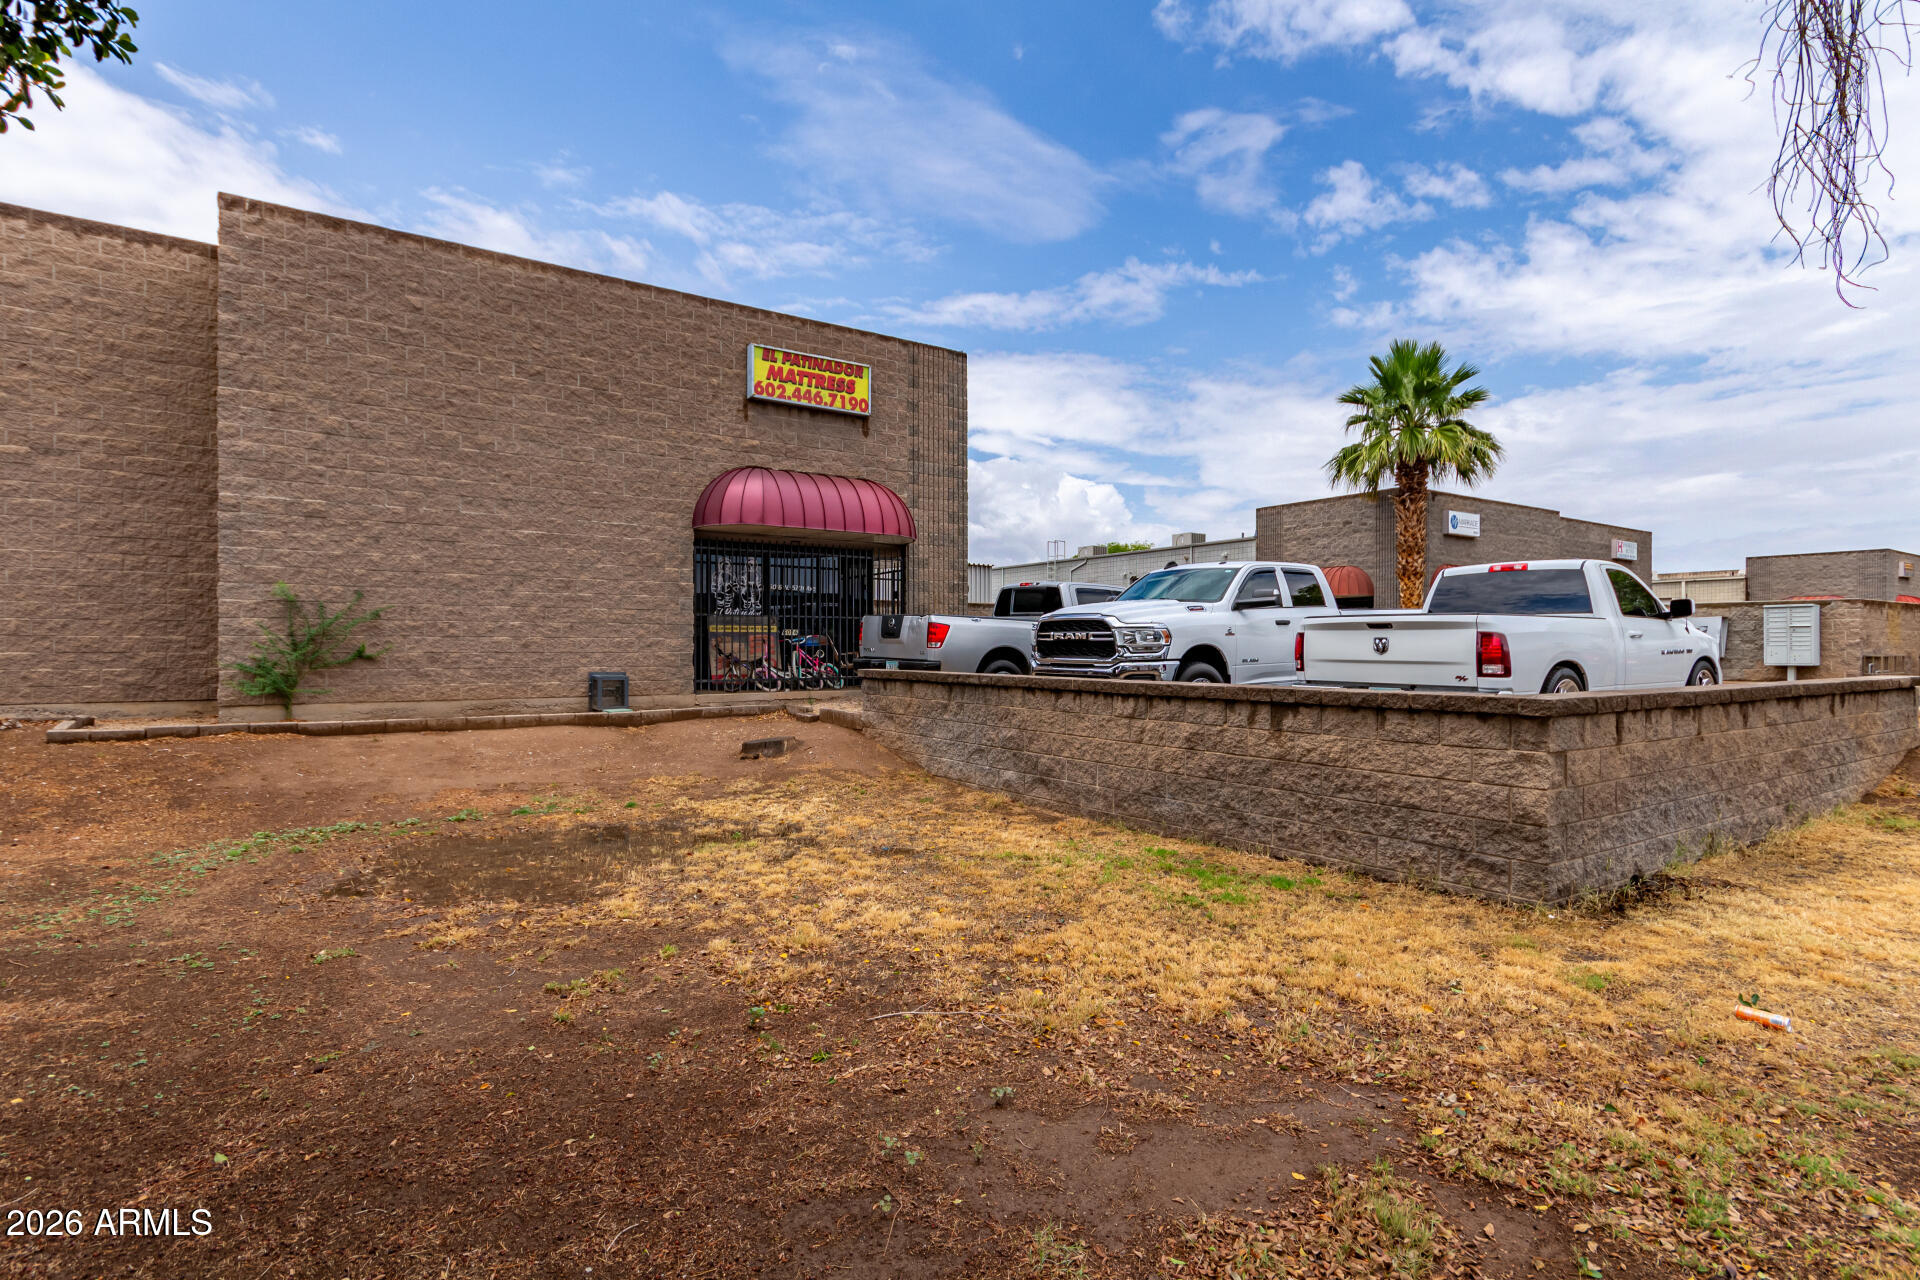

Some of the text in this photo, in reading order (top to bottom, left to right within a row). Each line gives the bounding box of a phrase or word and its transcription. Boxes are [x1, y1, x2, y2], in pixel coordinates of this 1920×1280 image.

[762, 348, 864, 379] EL PATINADOR
[766, 364, 856, 394] MATTRESS
[754, 380, 869, 413] 602.446.7190
[1053, 632, 1087, 640] RAM
